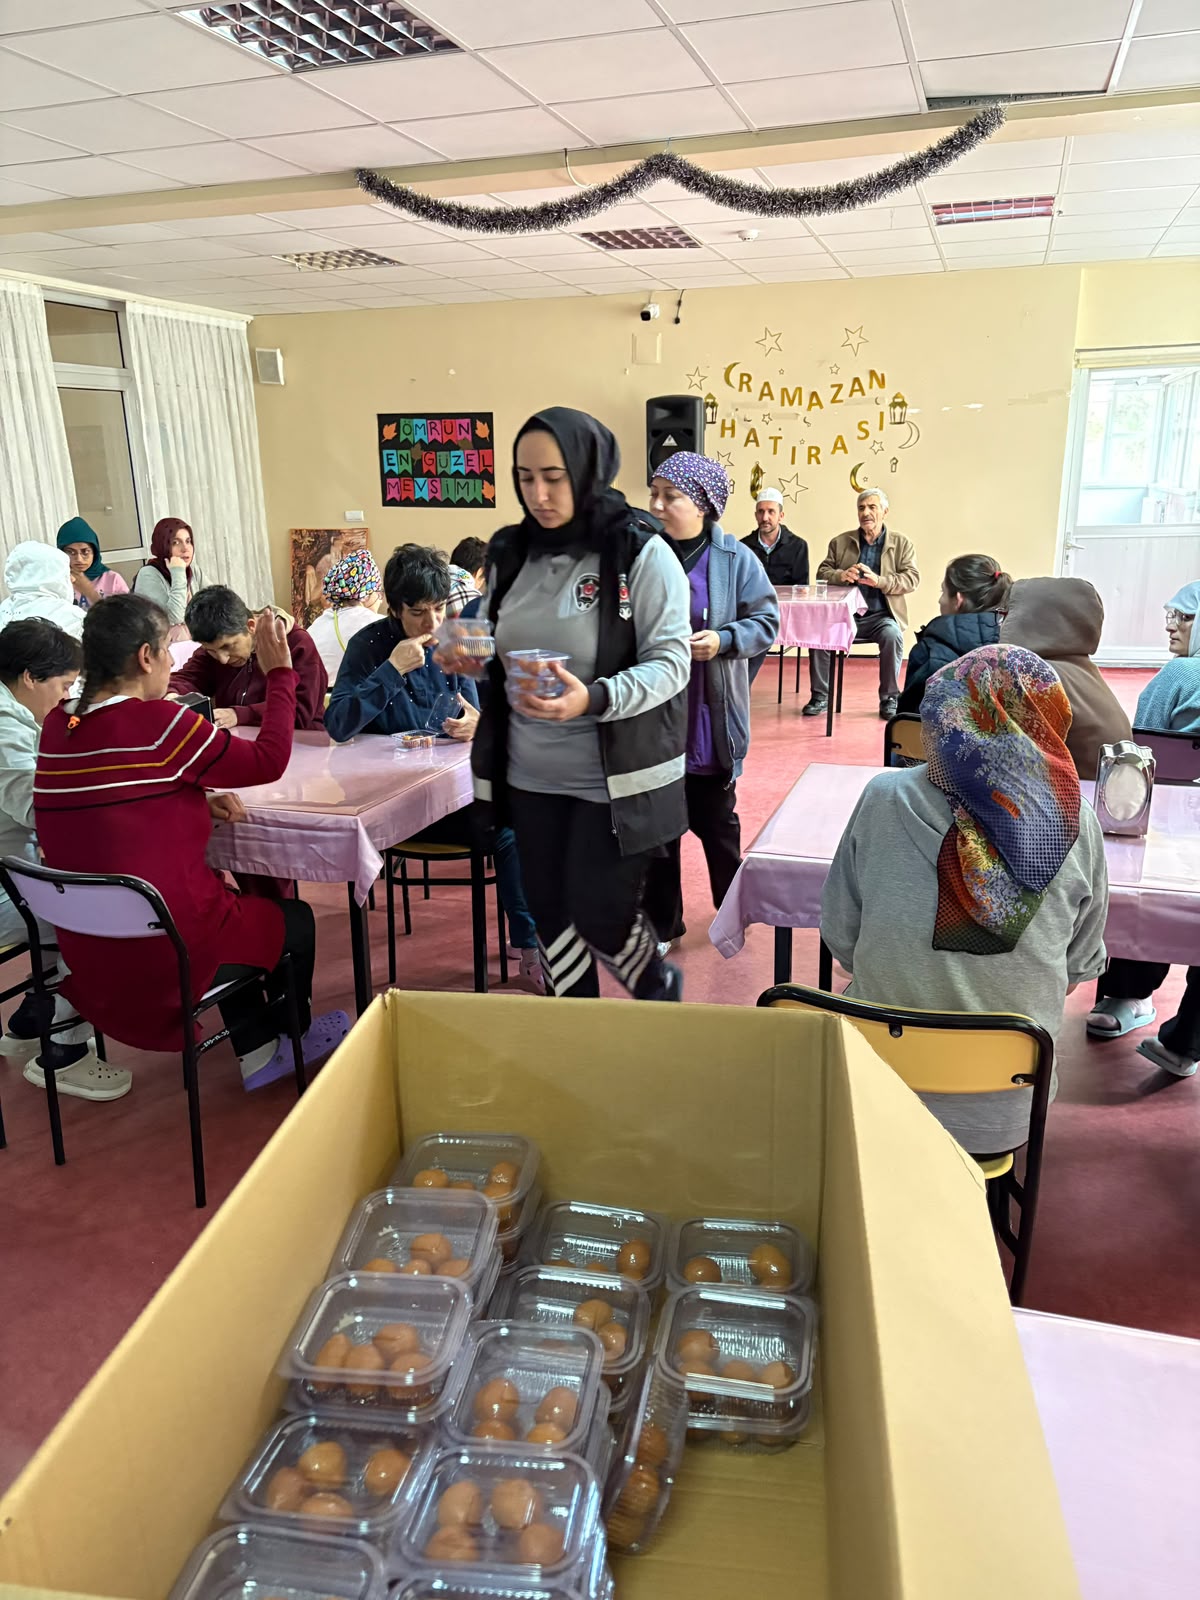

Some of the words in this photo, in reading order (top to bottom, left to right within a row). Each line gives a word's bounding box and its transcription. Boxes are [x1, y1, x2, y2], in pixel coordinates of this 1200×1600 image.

[738, 369, 886, 412] RAMAZAN
[402, 420, 470, 436] ÖMRÜN
[720, 411, 885, 465] HATIRASI
[386, 452, 409, 466] EN
[423, 452, 492, 469] GÜZEL
